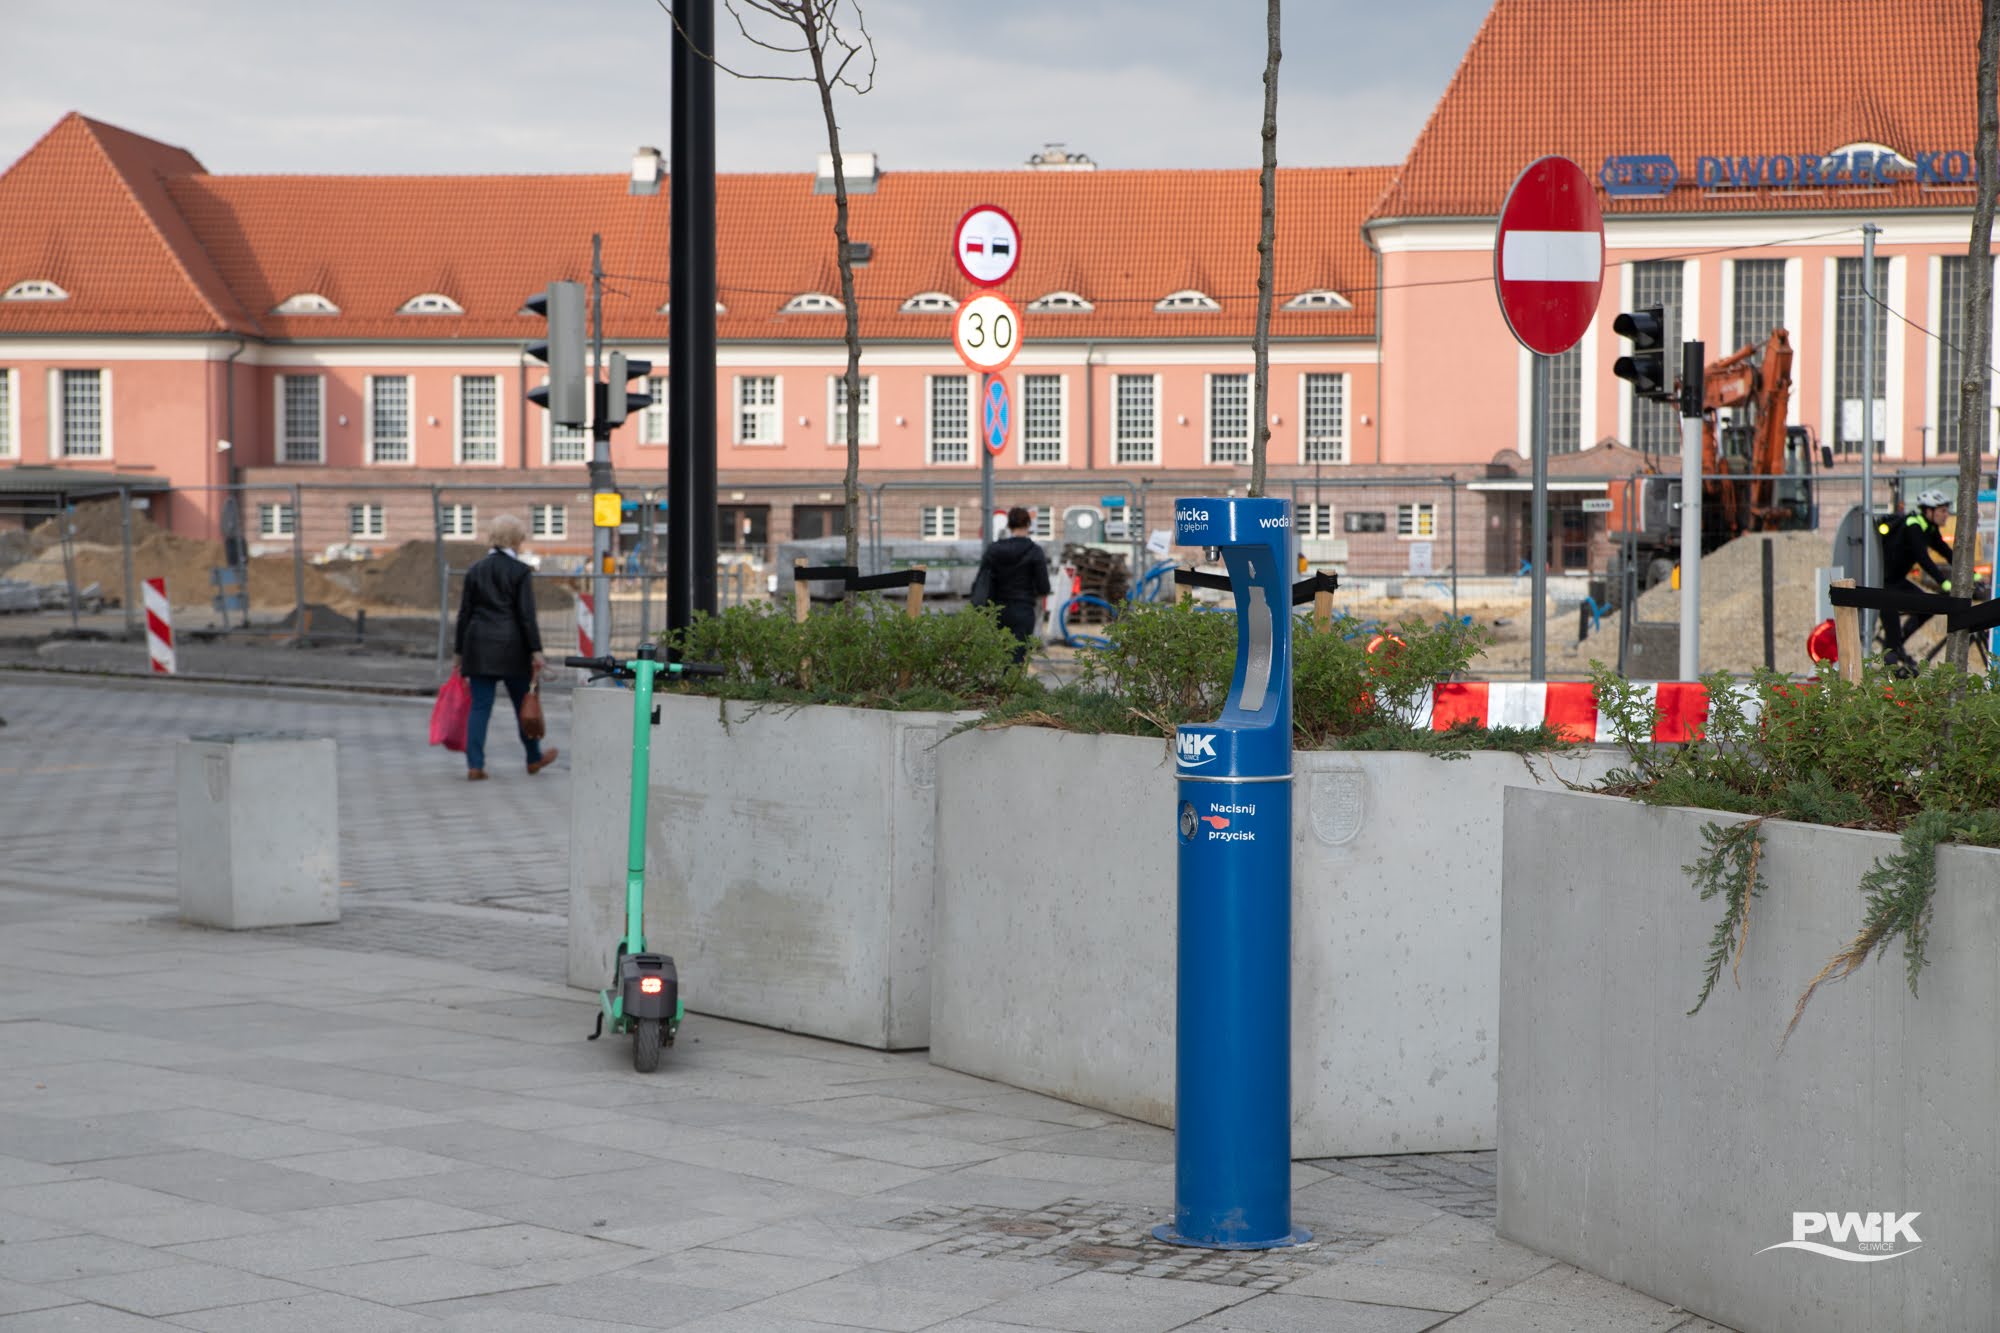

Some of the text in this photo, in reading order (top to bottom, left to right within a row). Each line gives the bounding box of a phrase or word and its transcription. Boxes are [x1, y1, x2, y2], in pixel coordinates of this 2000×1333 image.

[1698, 151, 1899, 187] DWORZEC
[1916, 150, 1980, 184] KO
[967, 312, 1012, 348] 30
[1176, 507, 1209, 521] wicka
[1259, 515, 1289, 528] woda
[1208, 831, 1256, 842] przycisk
